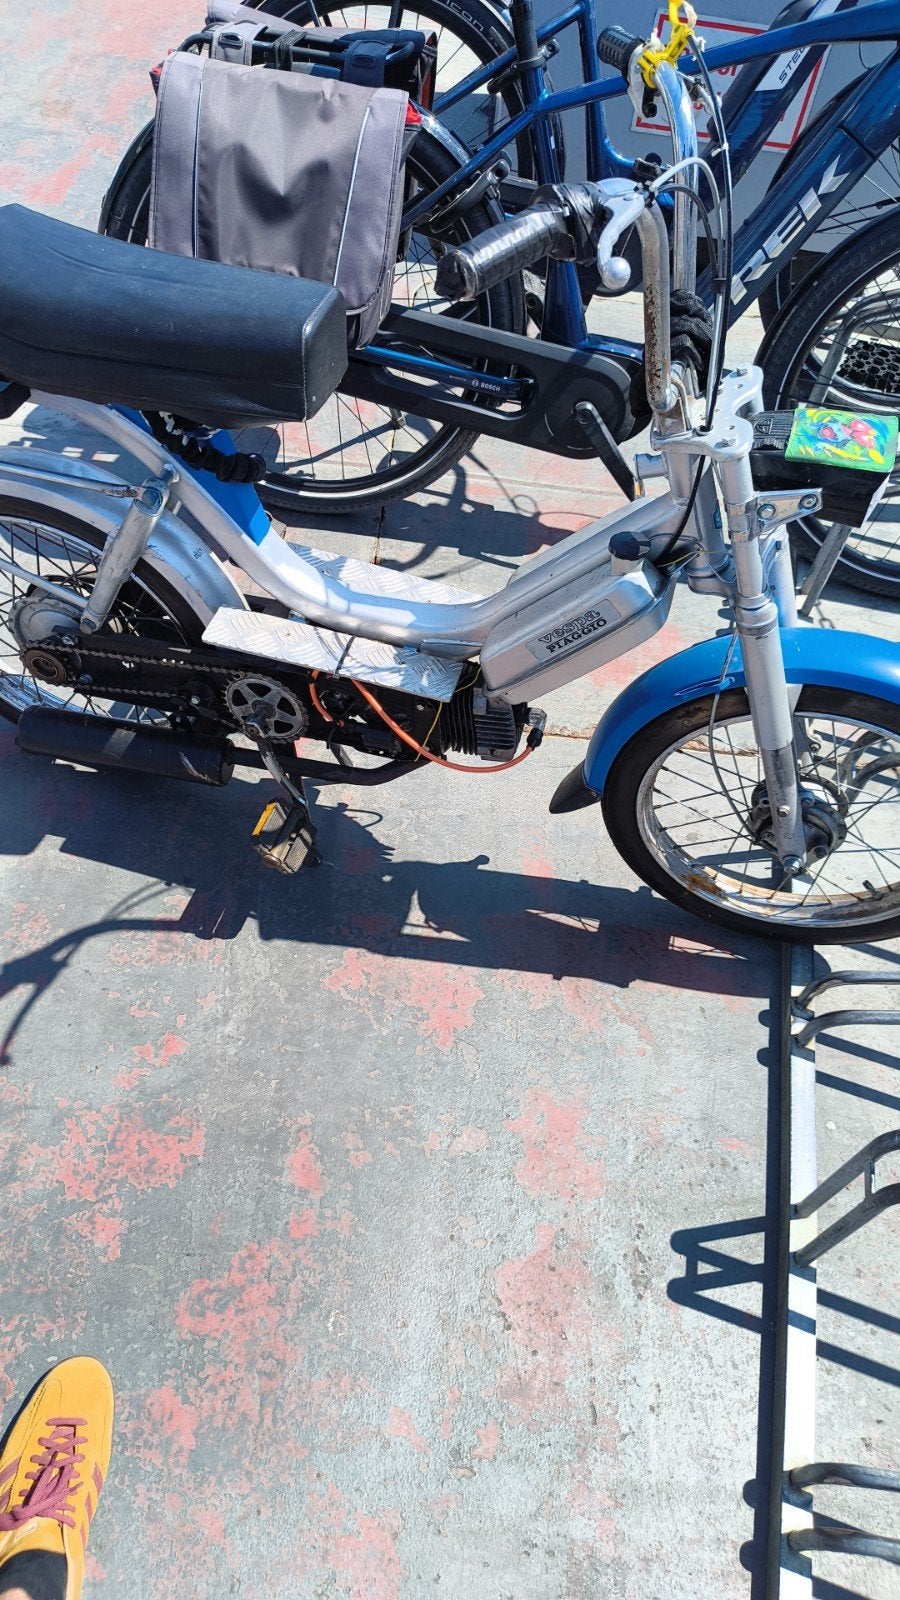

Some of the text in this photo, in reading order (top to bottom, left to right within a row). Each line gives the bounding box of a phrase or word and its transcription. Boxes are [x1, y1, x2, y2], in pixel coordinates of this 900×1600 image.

[730, 153, 850, 306] REK
[480, 382, 501, 392] BOSCH
[546, 617, 607, 653] PIAGGIO
